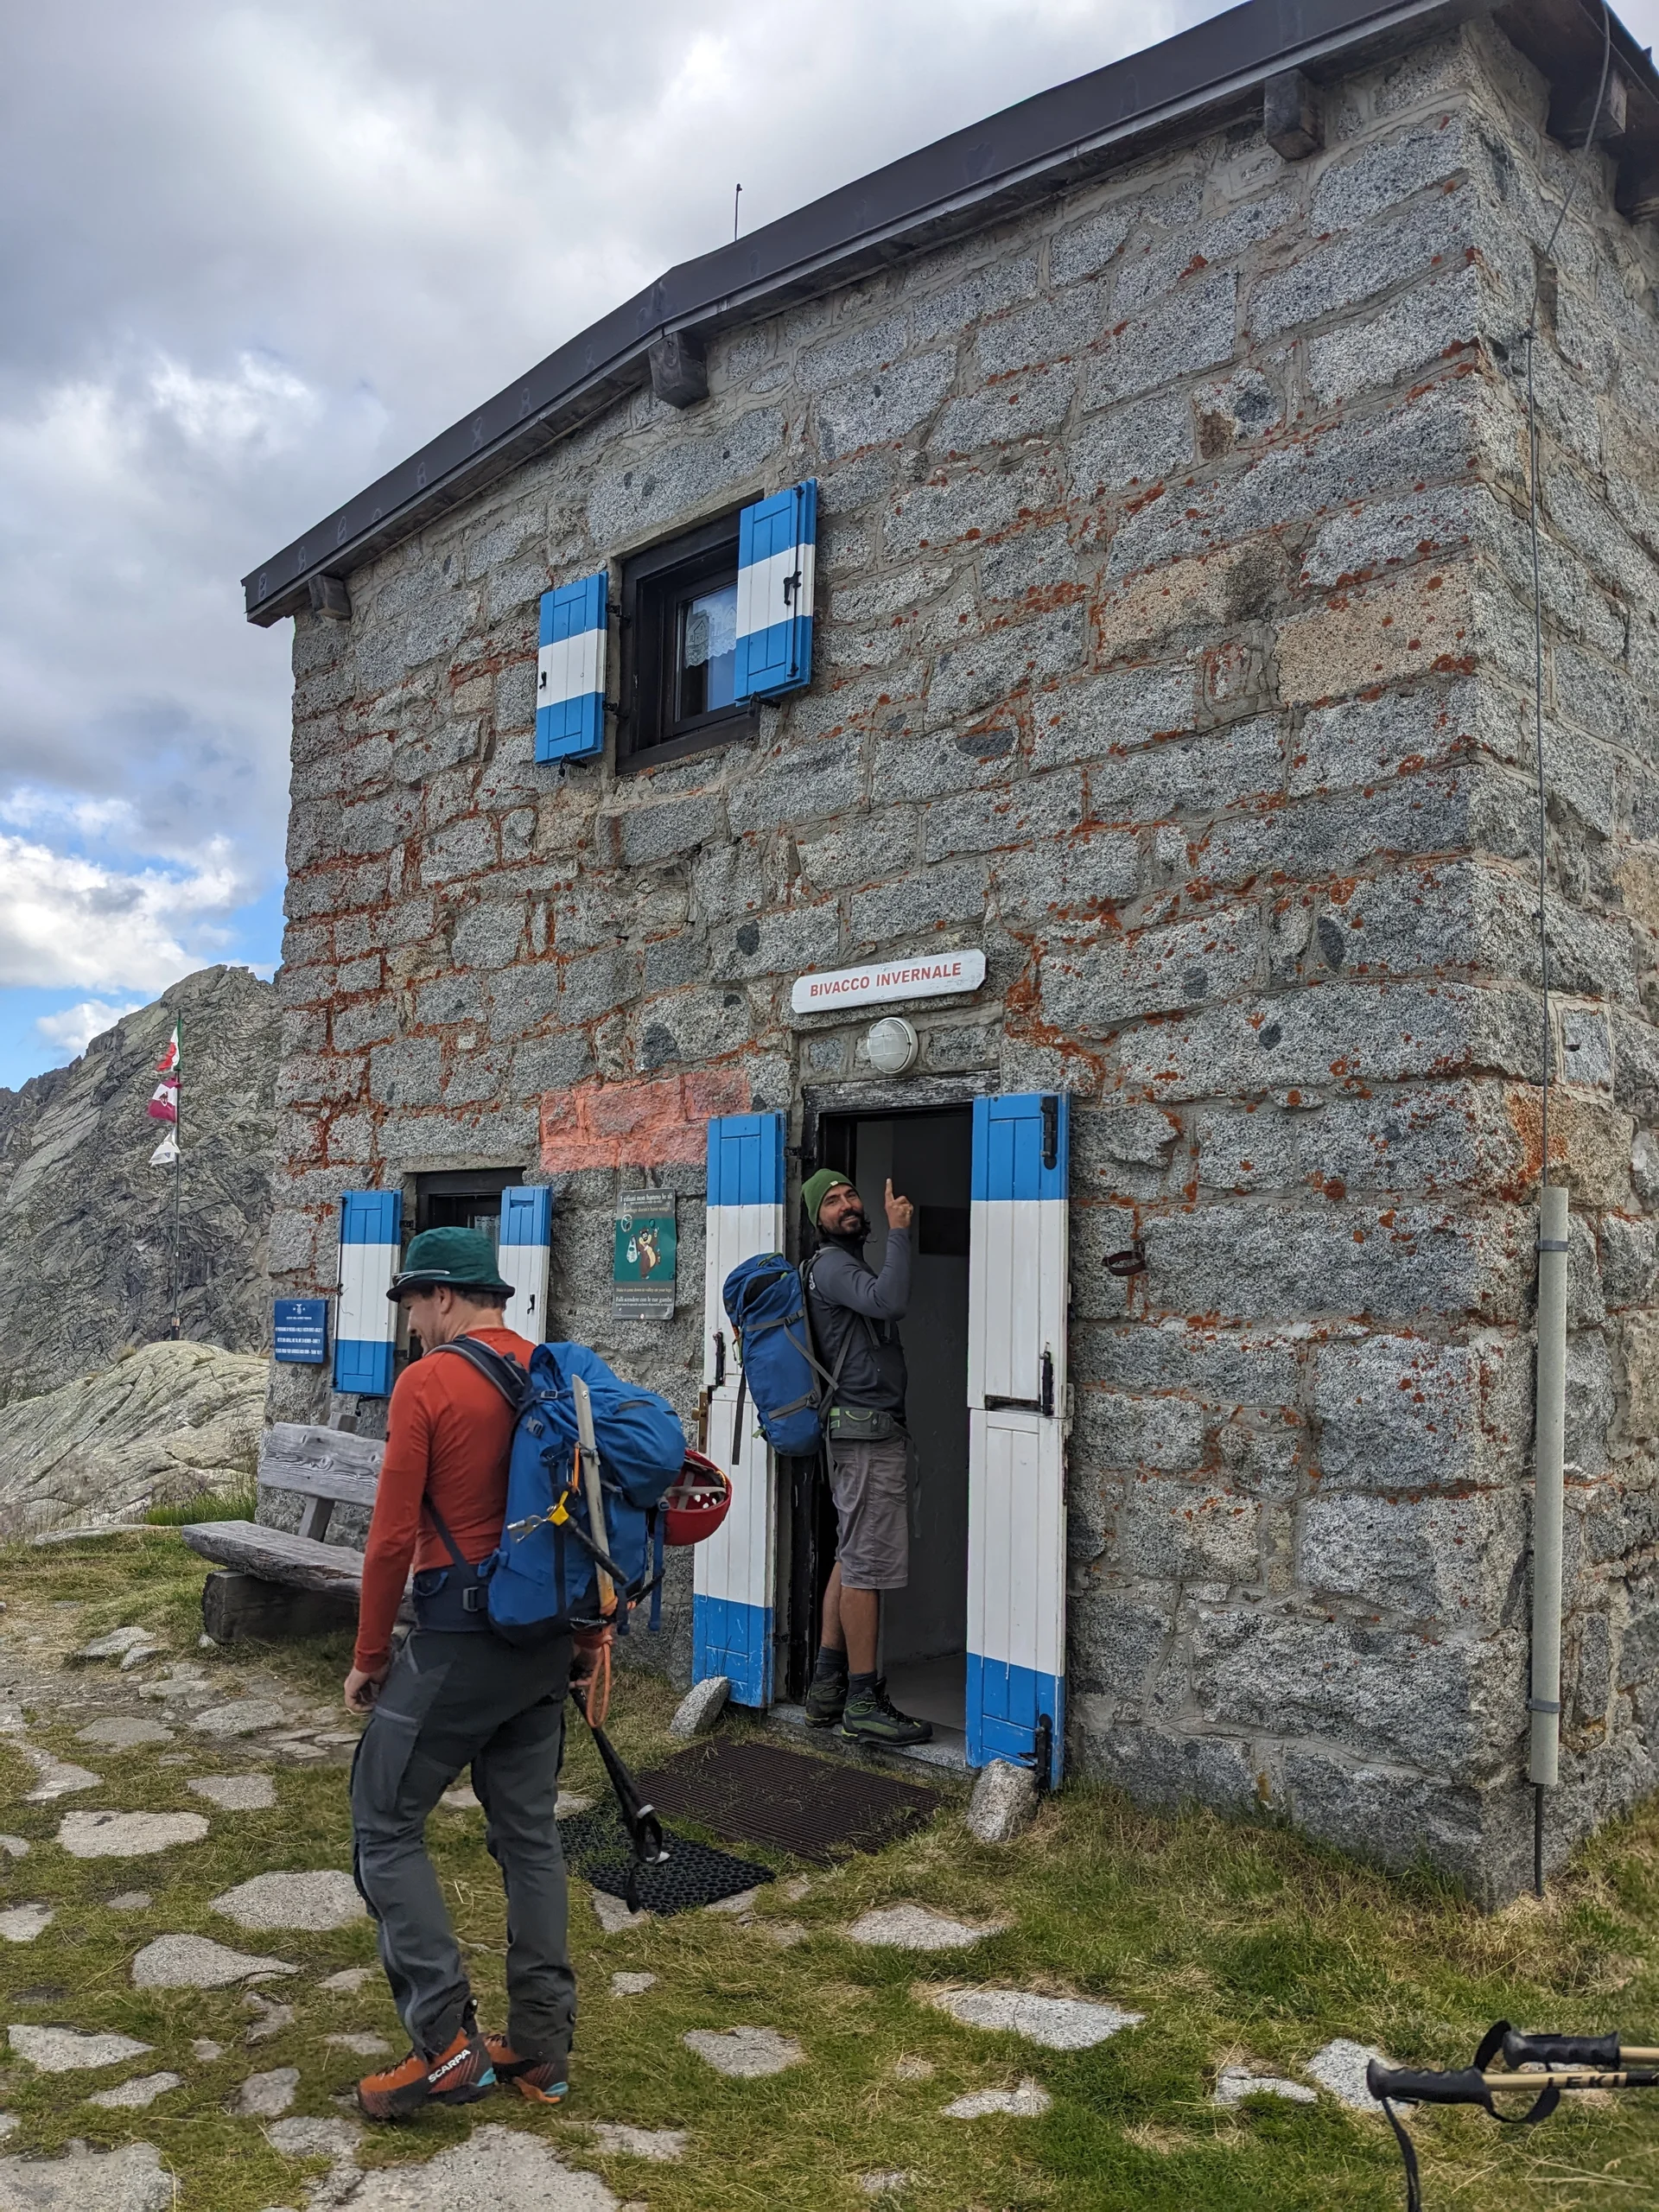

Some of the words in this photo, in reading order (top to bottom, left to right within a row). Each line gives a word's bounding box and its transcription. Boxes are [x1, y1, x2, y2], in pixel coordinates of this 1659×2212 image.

[810, 976, 870, 997] BIVACCO
[875, 962, 962, 987] INVERNALE
[428, 2049, 472, 2083] SCARPA
